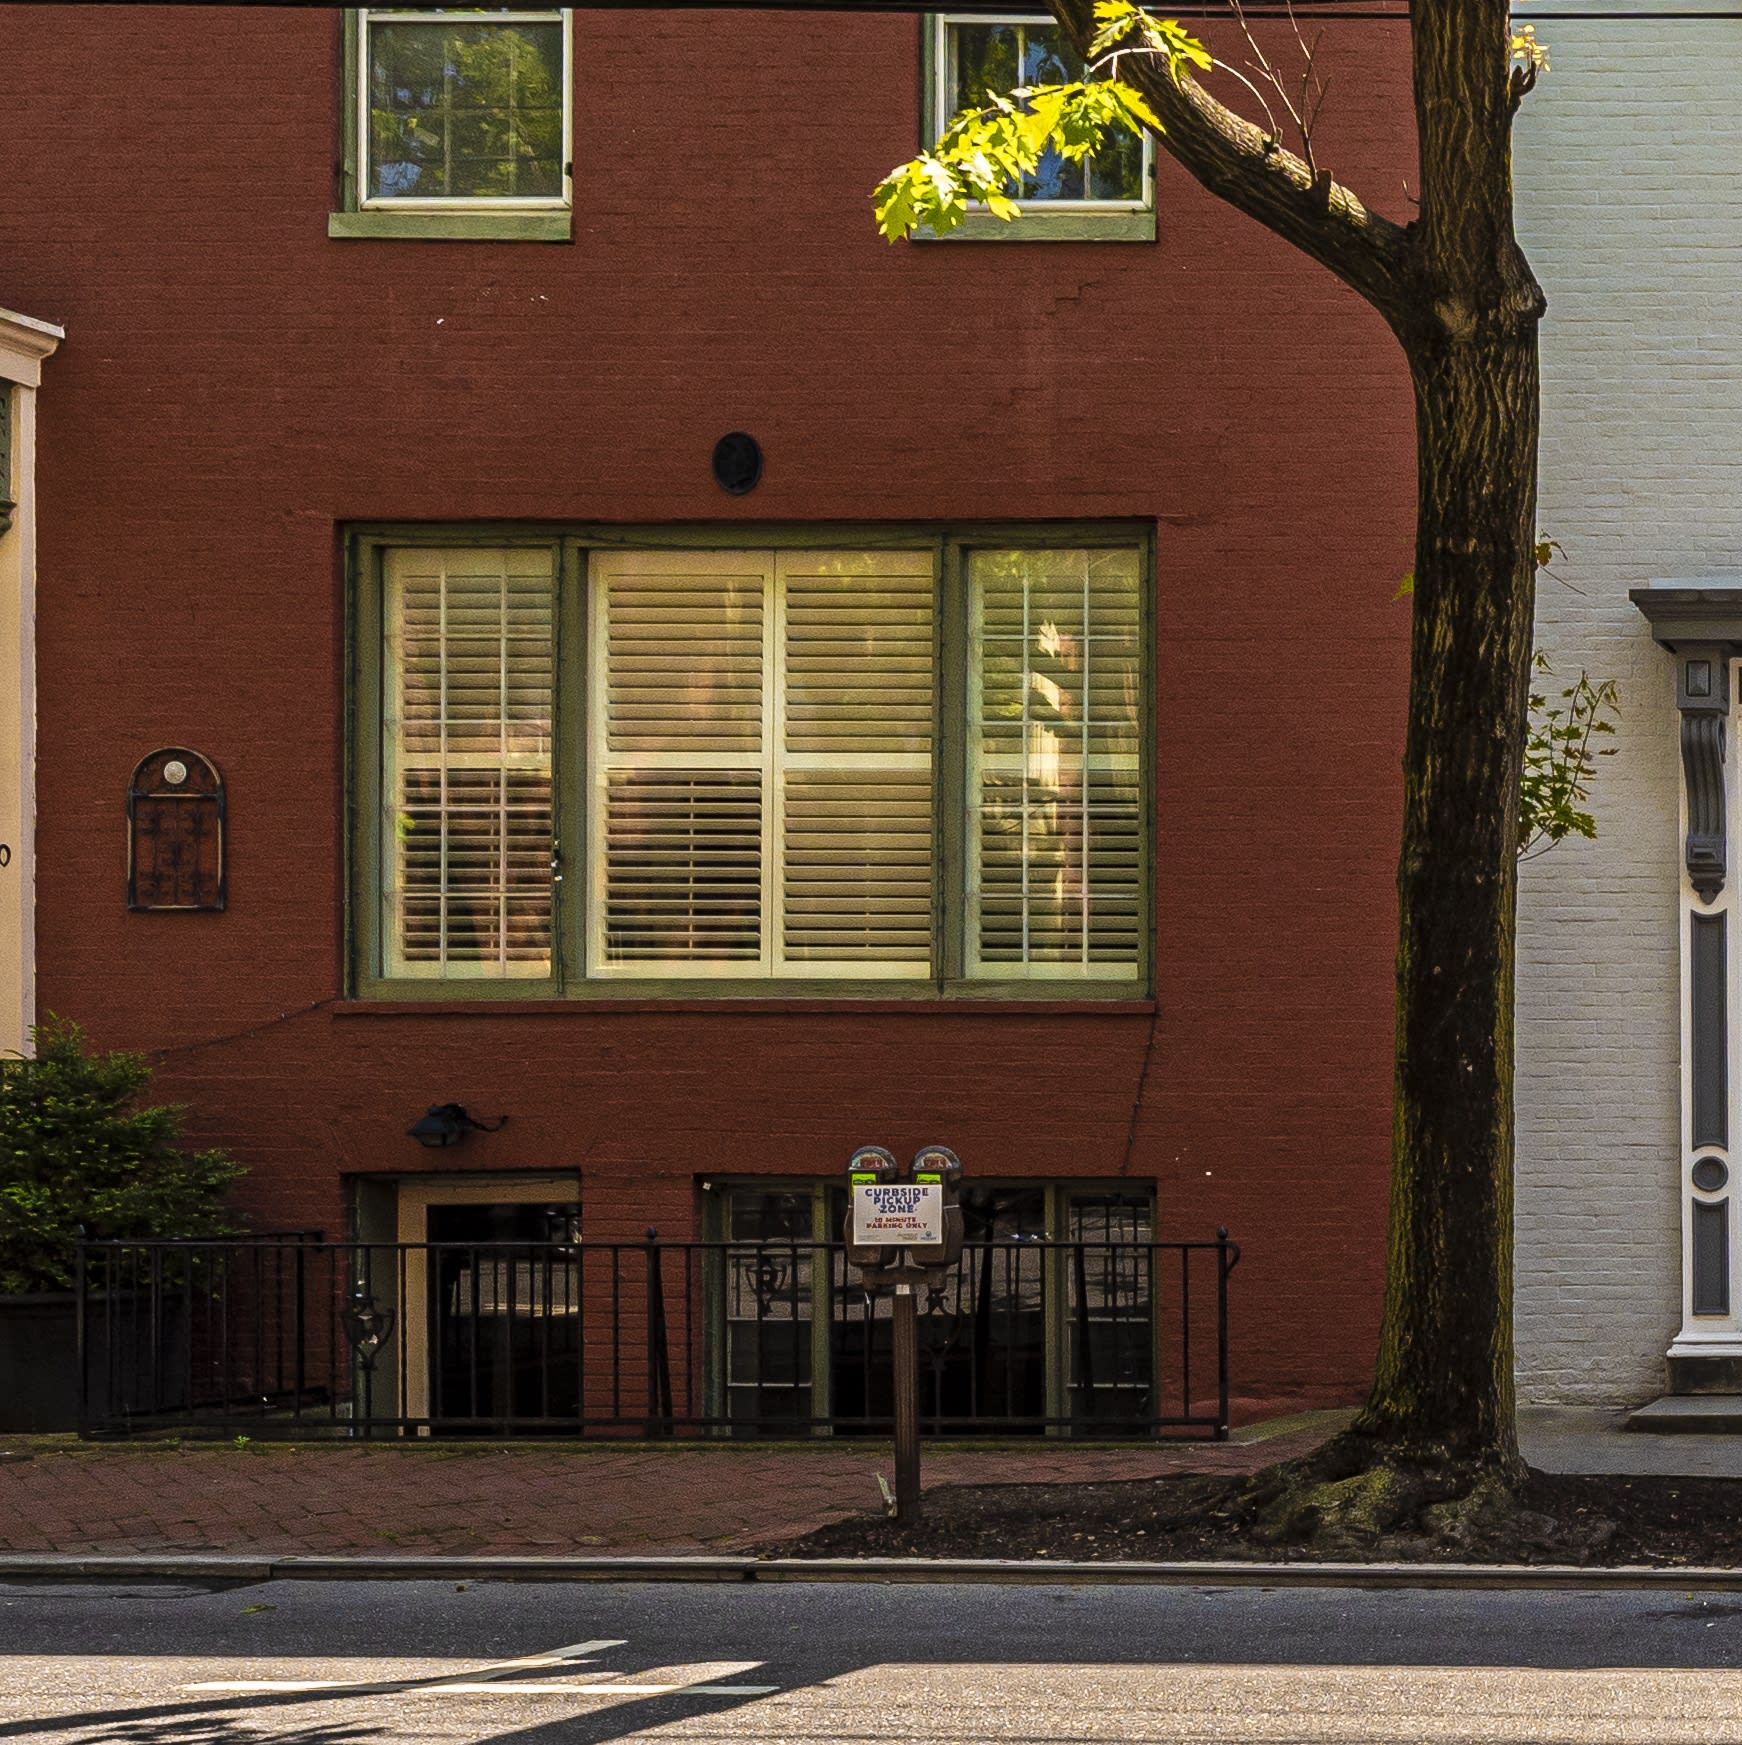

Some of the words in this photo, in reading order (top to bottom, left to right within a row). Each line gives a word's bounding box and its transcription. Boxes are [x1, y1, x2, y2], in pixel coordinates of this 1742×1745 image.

[865, 1188, 928, 1196] CURBSIDE
[873, 1197, 920, 1205] PICKUP
[879, 1205, 915, 1213] ZONE
